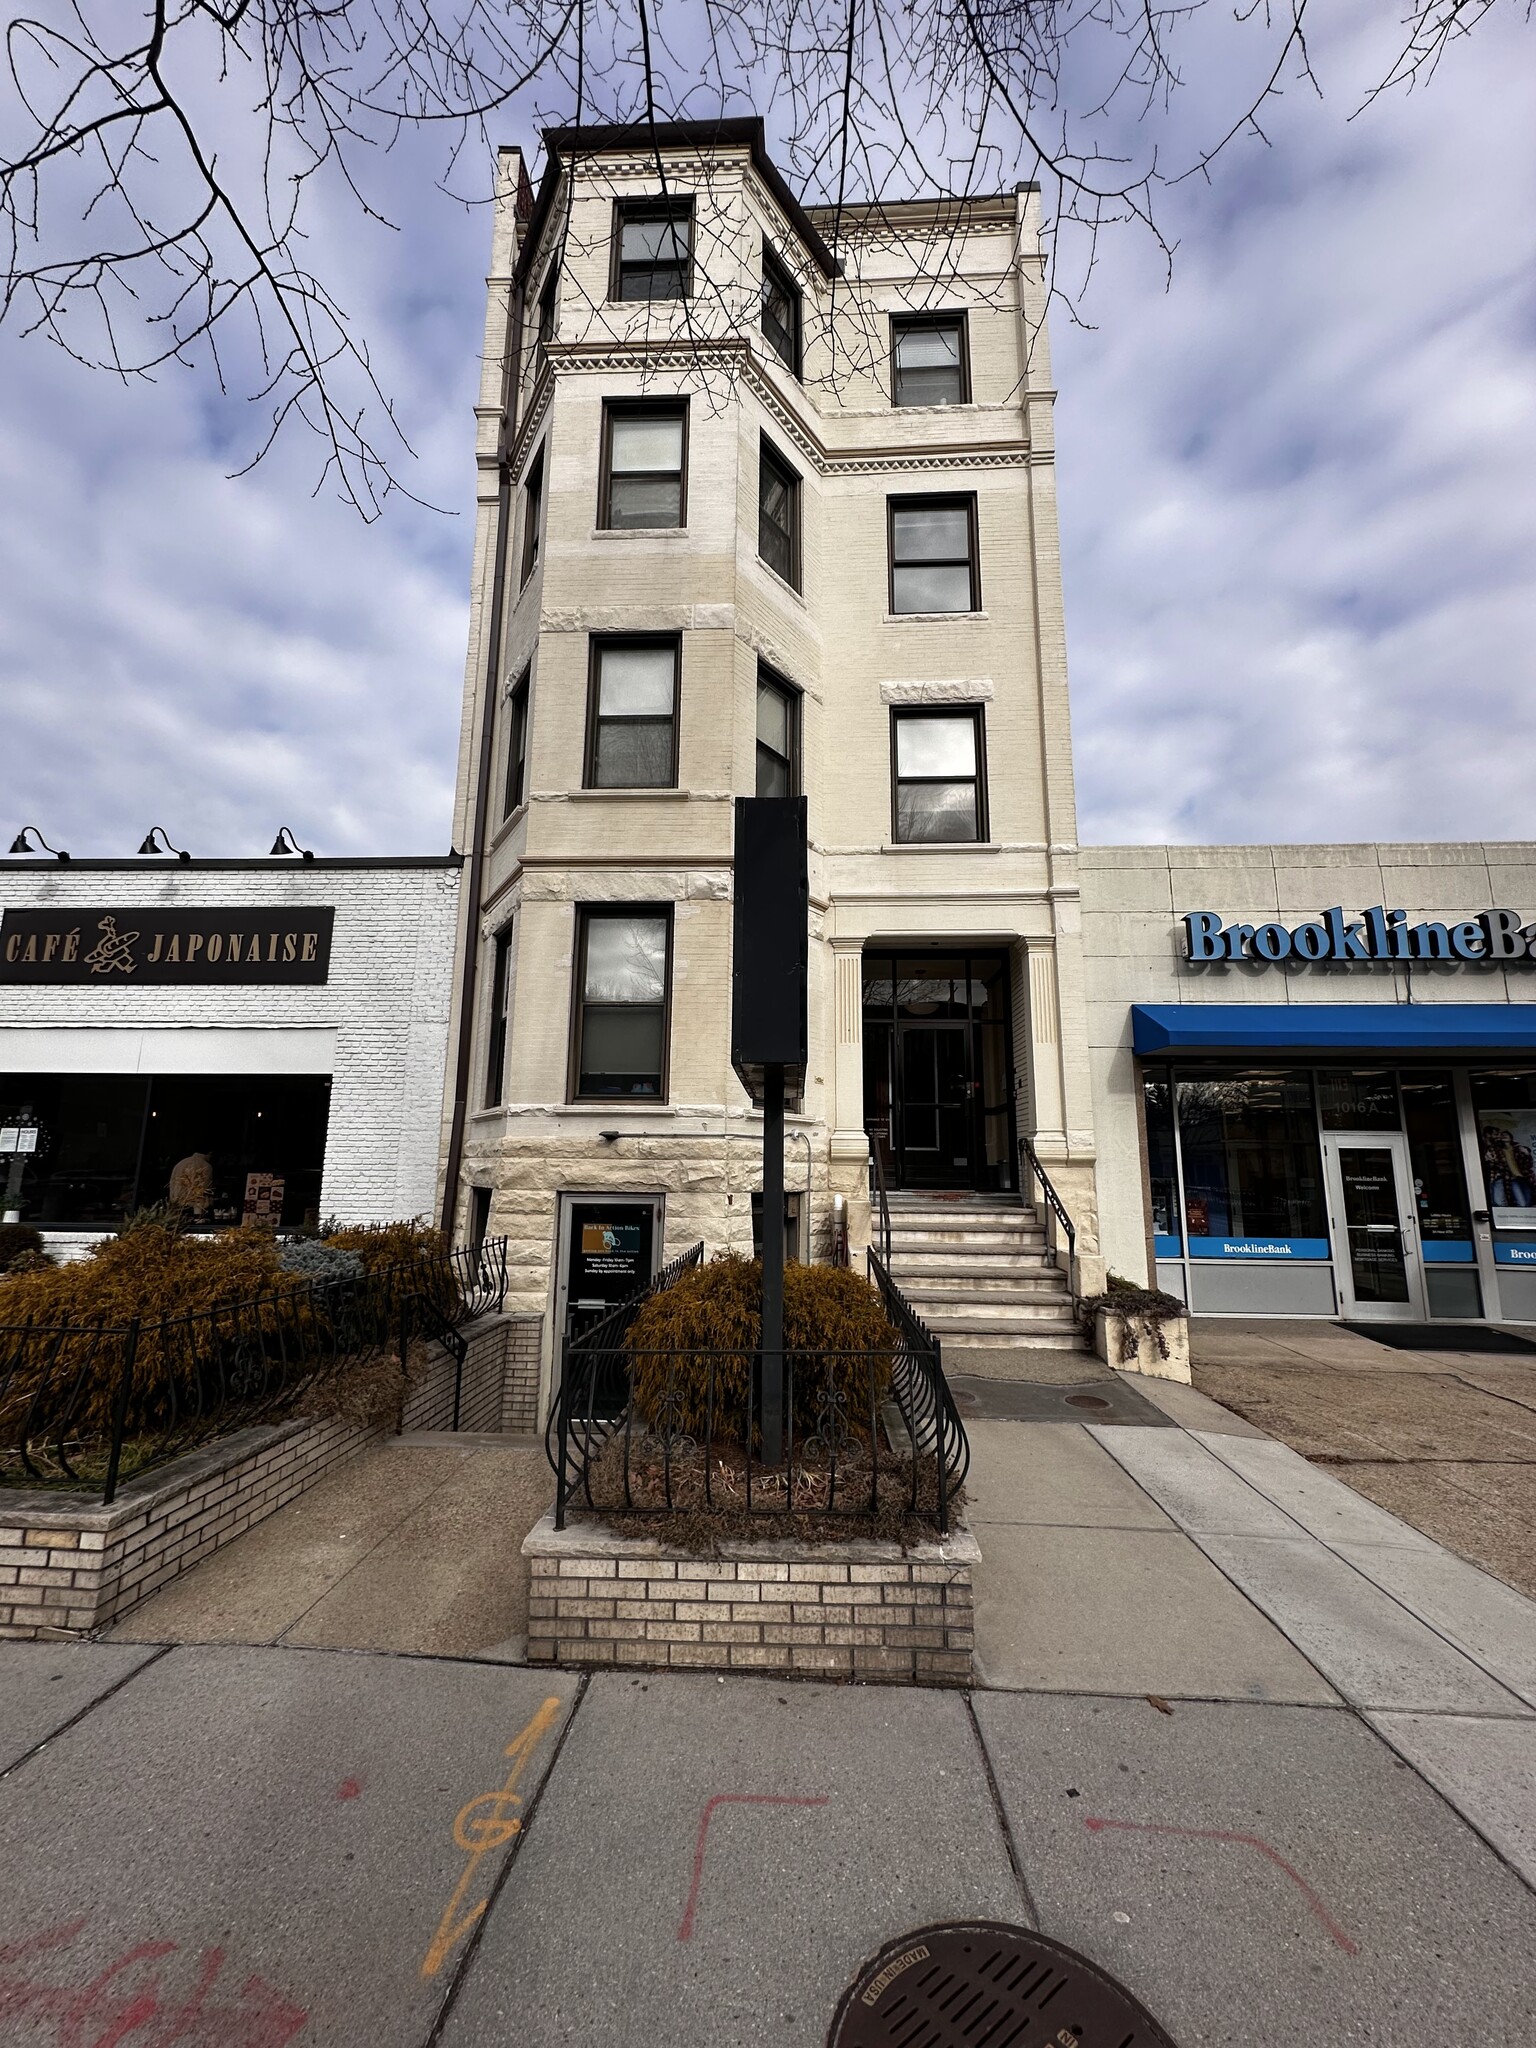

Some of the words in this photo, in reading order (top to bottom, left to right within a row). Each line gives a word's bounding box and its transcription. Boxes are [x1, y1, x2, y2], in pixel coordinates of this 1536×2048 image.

[5, 927, 81, 963] CAFÉ
[147, 933, 319, 963] JAPONAISE
[1223, 1243, 1292, 1254] BrooklineBank
[896, 1947, 927, 1970] MADE
[882, 1966, 897, 1981] IN
[863, 1979, 885, 2002] USA
